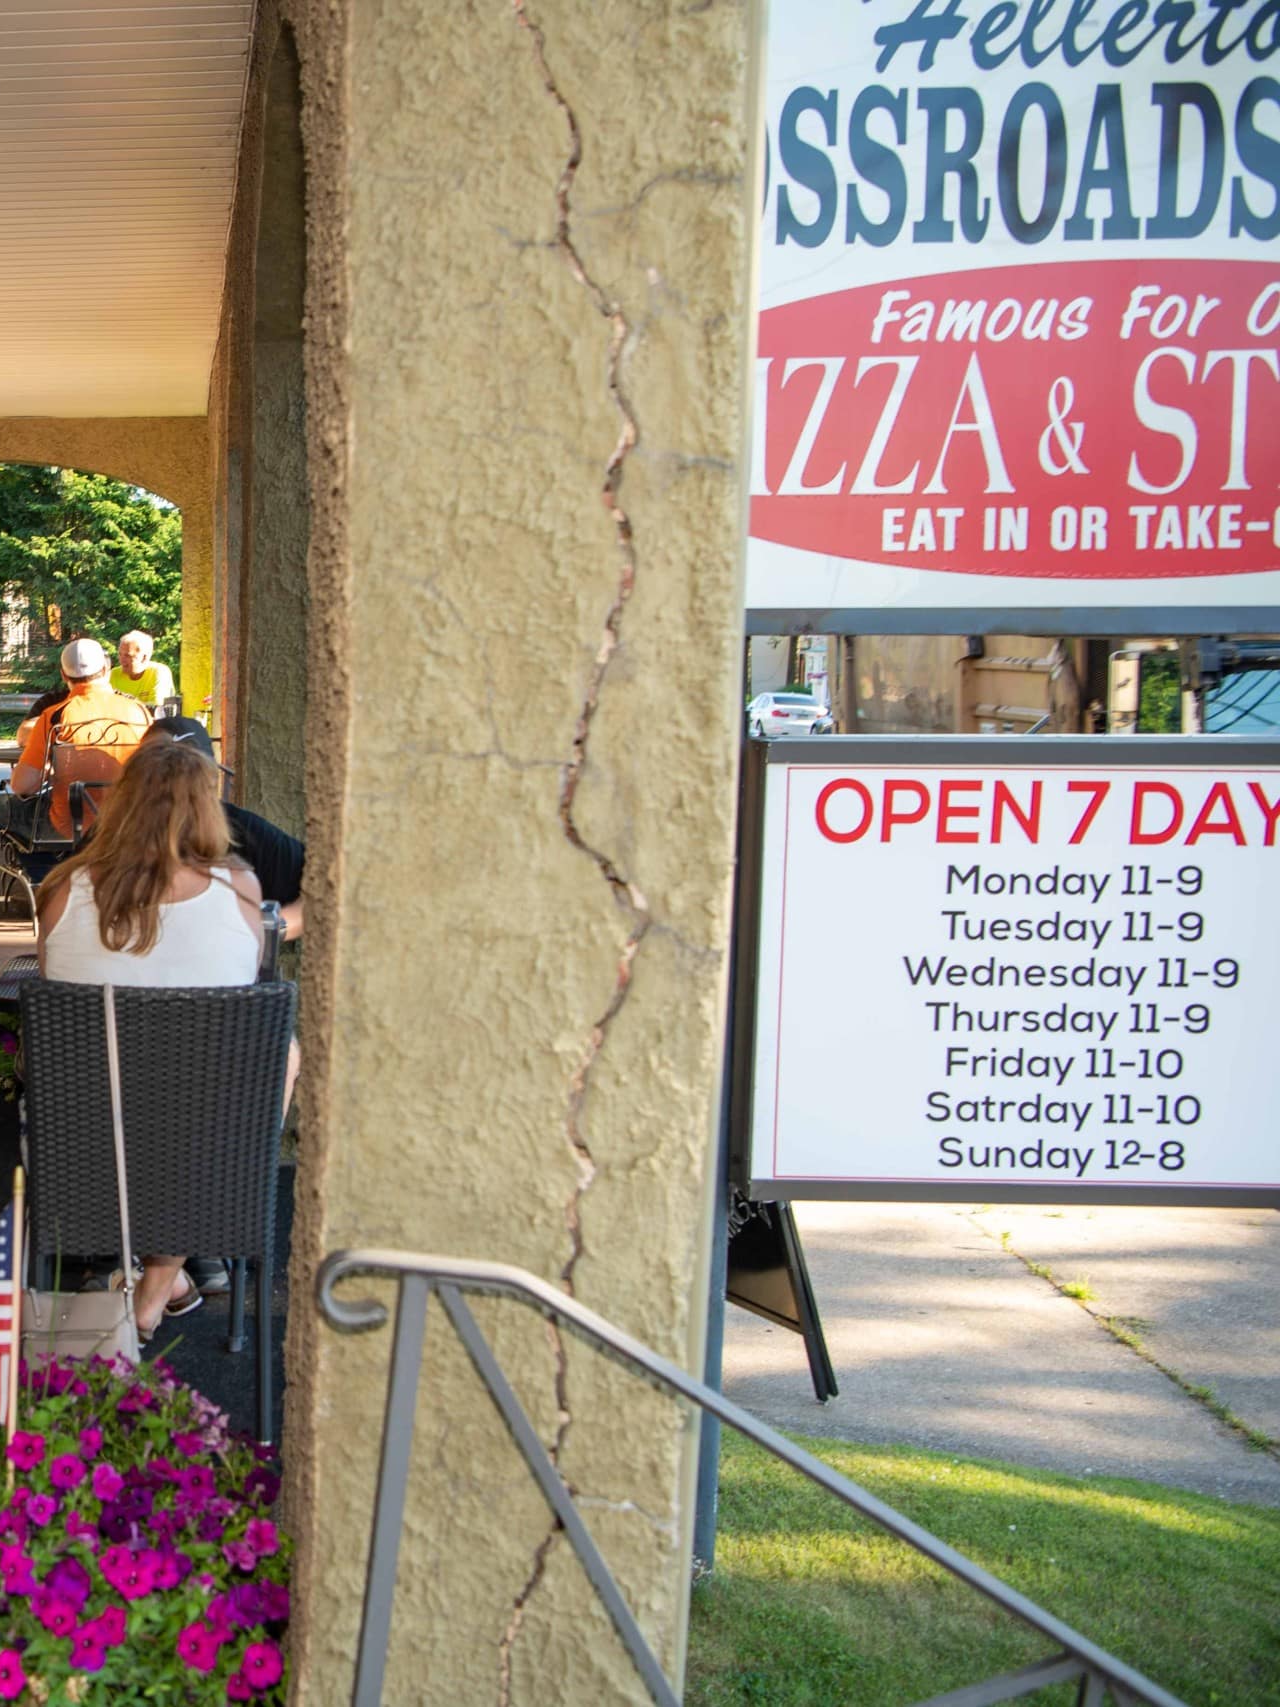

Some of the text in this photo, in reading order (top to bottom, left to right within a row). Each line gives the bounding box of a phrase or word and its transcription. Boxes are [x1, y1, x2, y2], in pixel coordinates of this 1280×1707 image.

[764, 76, 1280, 248] SSROADS
[870, 289, 1093, 343] Famous
[1120, 284, 1220, 339] For
[1037, 376, 1091, 475] &
[881, 504, 1280, 552] EAT IN OR TAKE-
[814, 777, 1280, 847] OPEN 7 DAY
[946, 864, 1203, 904] Monday 11-9
[941, 910, 1204, 950] Tuesday 11-9
[903, 956, 1240, 996] Wednesday 11-9
[925, 1002, 1210, 1041] Thursday 11-9
[945, 1047, 1183, 1086] Friday 11-10
[925, 1091, 1201, 1132] Satrday 11-10
[938, 1136, 1185, 1178] Sunday 12-8
